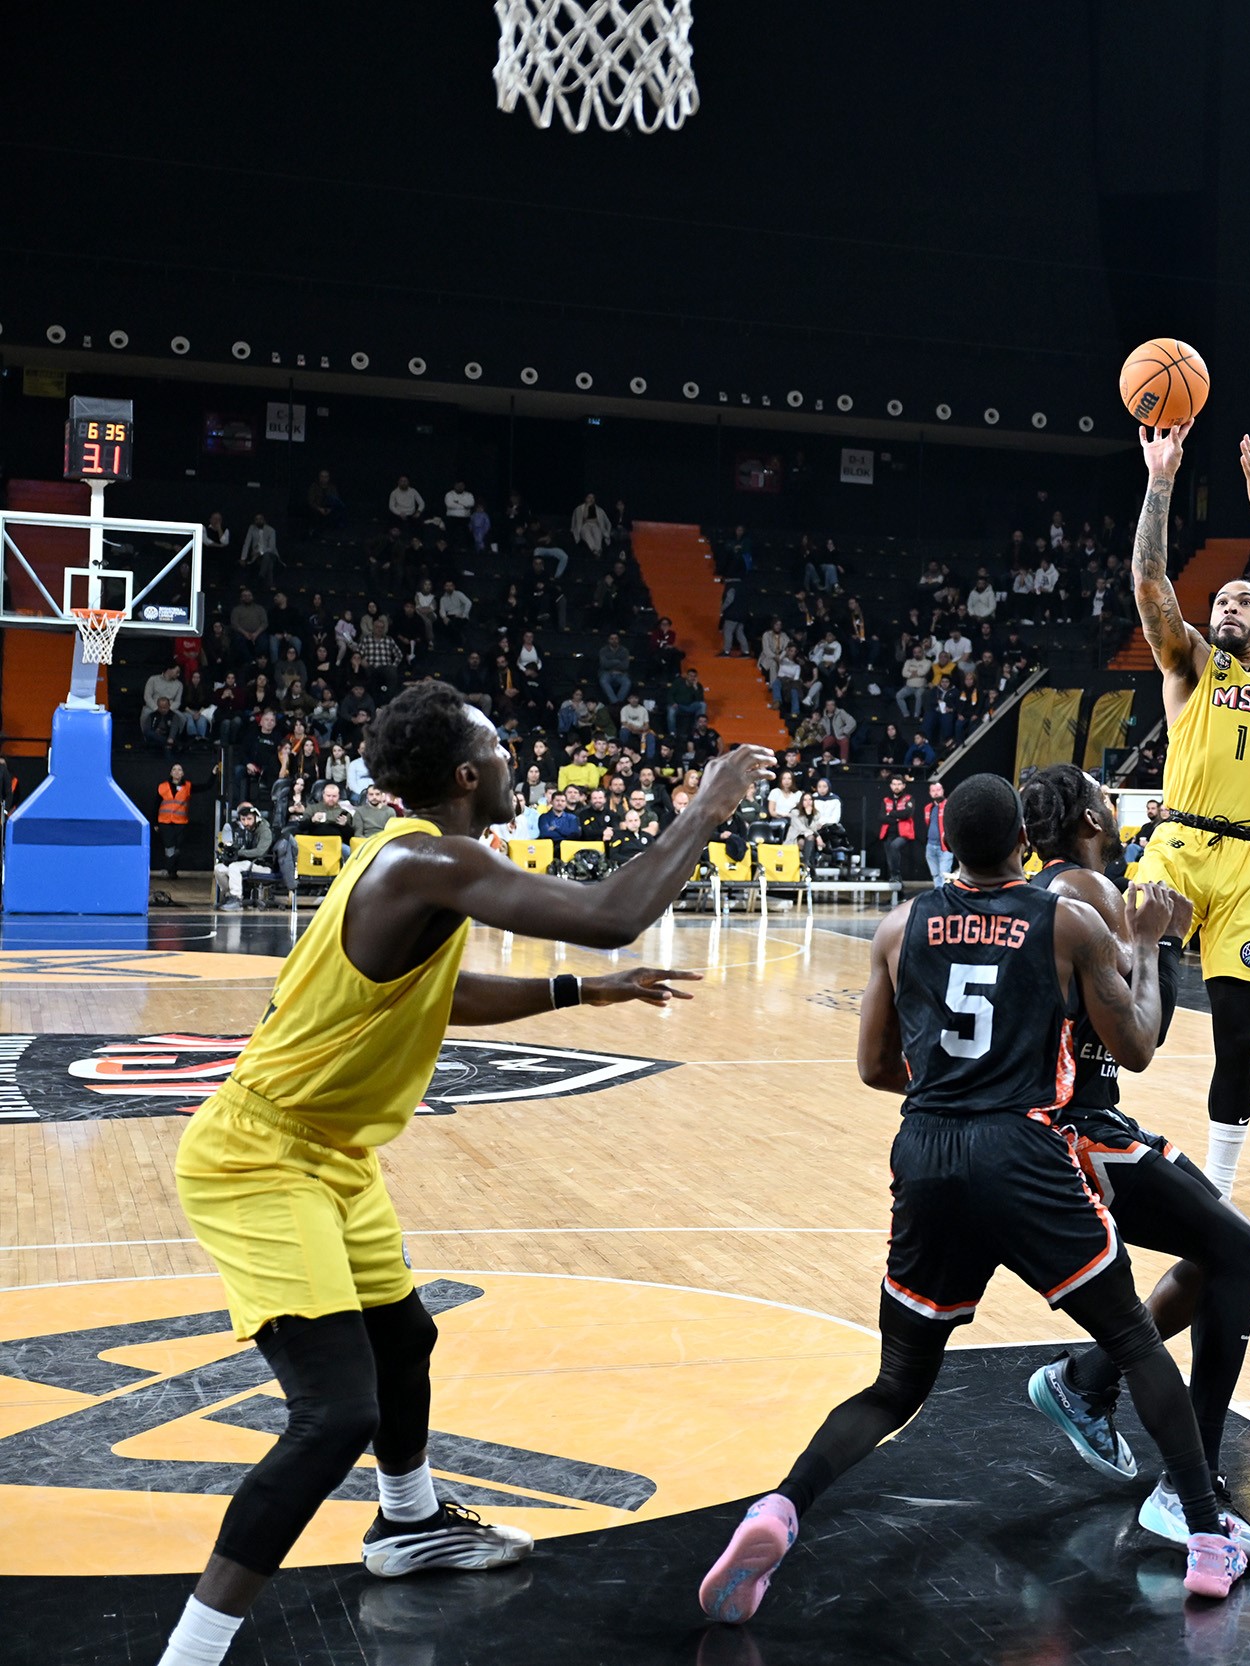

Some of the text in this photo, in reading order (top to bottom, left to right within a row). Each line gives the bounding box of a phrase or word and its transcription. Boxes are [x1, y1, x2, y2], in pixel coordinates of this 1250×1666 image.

[82, 443, 121, 475] 3.1
[1235, 725, 1248, 761] 1
[927, 914, 1030, 949] BOGUES
[940, 963, 999, 1059] 5
